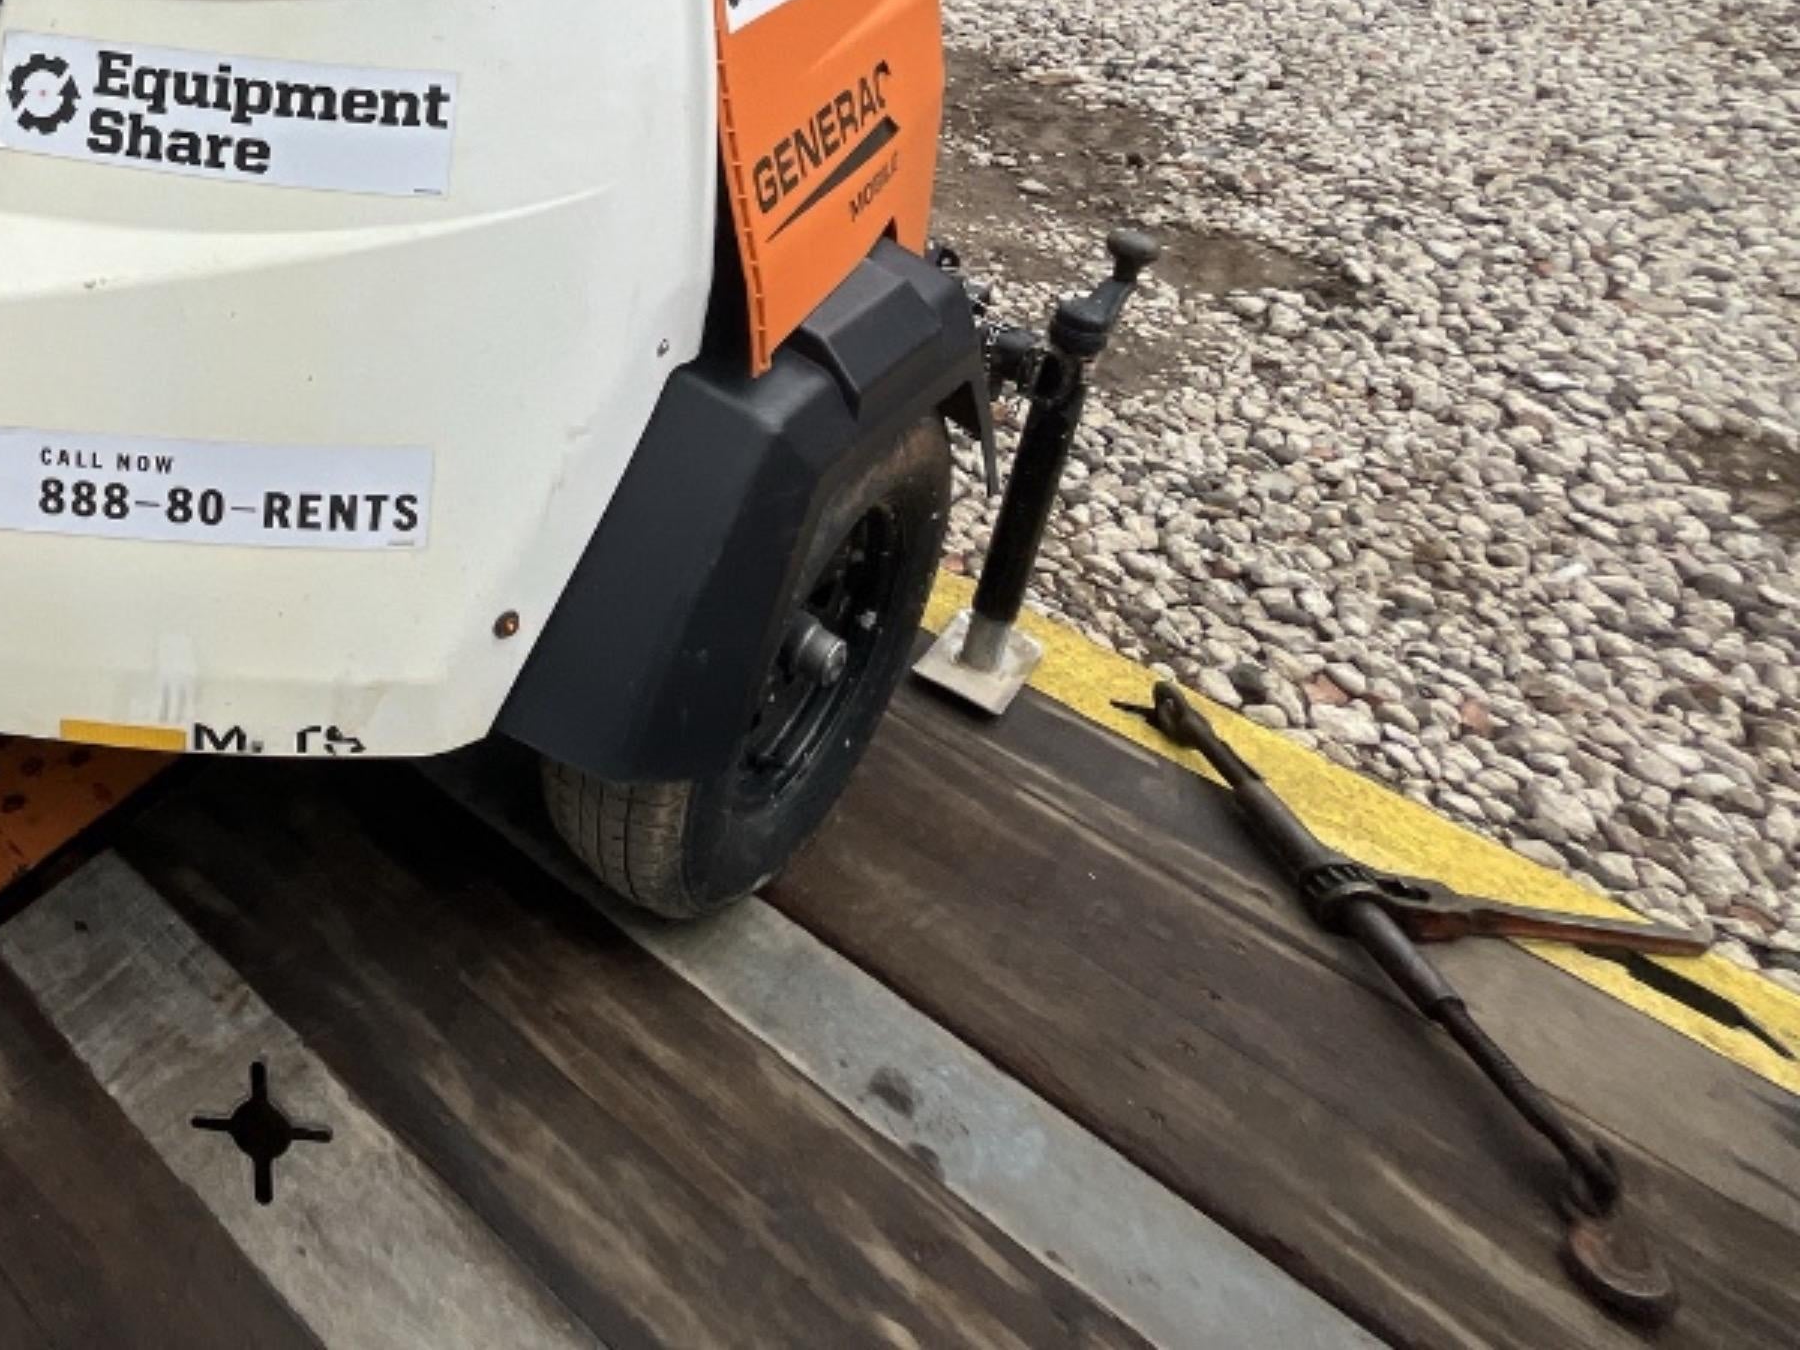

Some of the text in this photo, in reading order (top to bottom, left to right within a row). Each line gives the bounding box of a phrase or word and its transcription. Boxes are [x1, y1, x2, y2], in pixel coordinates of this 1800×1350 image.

[93, 50, 451, 130] Equipment
[86, 108, 272, 175] Share
[752, 60, 891, 214] GENERAC
[39, 446, 175, 475] CALL NOW
[38, 477, 420, 533] 888-80-RENTS
